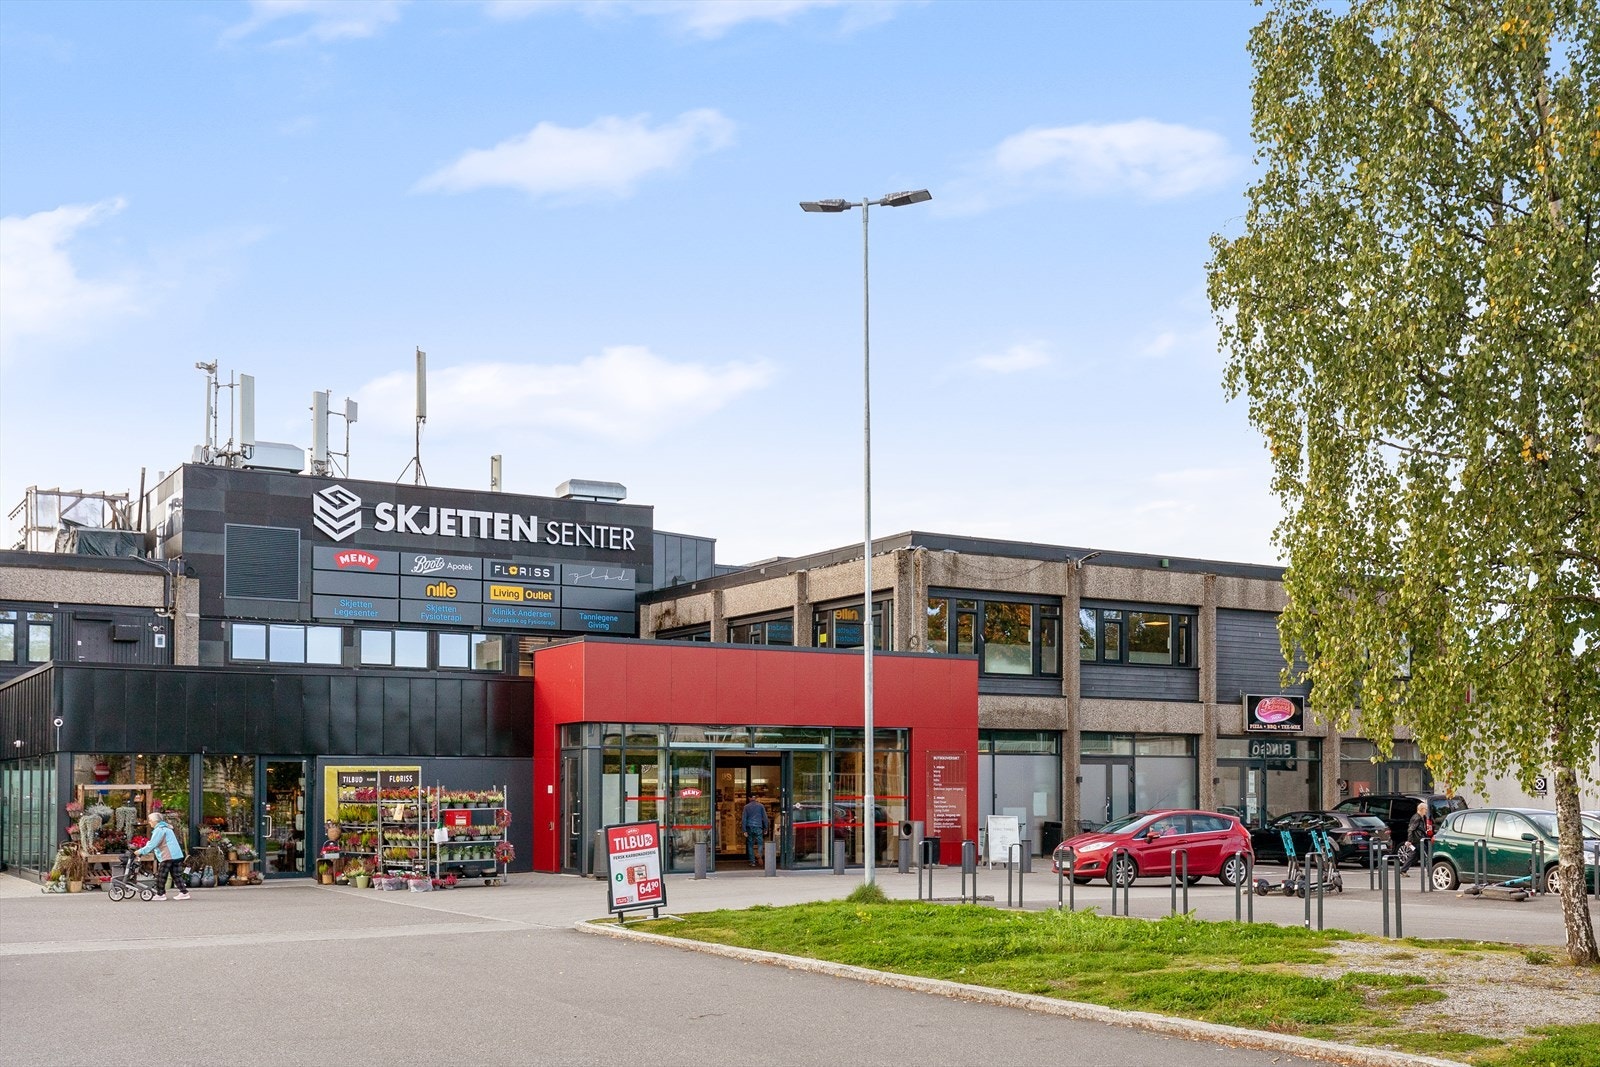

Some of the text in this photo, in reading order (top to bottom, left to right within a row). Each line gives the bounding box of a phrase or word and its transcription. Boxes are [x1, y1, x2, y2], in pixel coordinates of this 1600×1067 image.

[374, 502, 636, 551] SKJETTEN SENTER
[338, 553, 375, 567] MENY
[411, 555, 473, 574] Boots Apotek
[494, 565, 551, 578] FLORISS
[426, 581, 457, 598] nille
[493, 588, 553, 600] Living Outlet
[340, 599, 373, 610] Skjetten
[425, 603, 457, 614] Skjetten
[334, 607, 379, 618] Legesenter
[420, 612, 462, 622] Fysioterapi
[492, 607, 552, 618] Klinikk Andersen
[579, 612, 619, 622] Tannlegene
[588, 621, 610, 631] Giving
[342, 776, 364, 784] TILBUD
[389, 774, 413, 783] FLORISS
[682, 789, 700, 797] MENY
[614, 834, 653, 850] TILBUD
